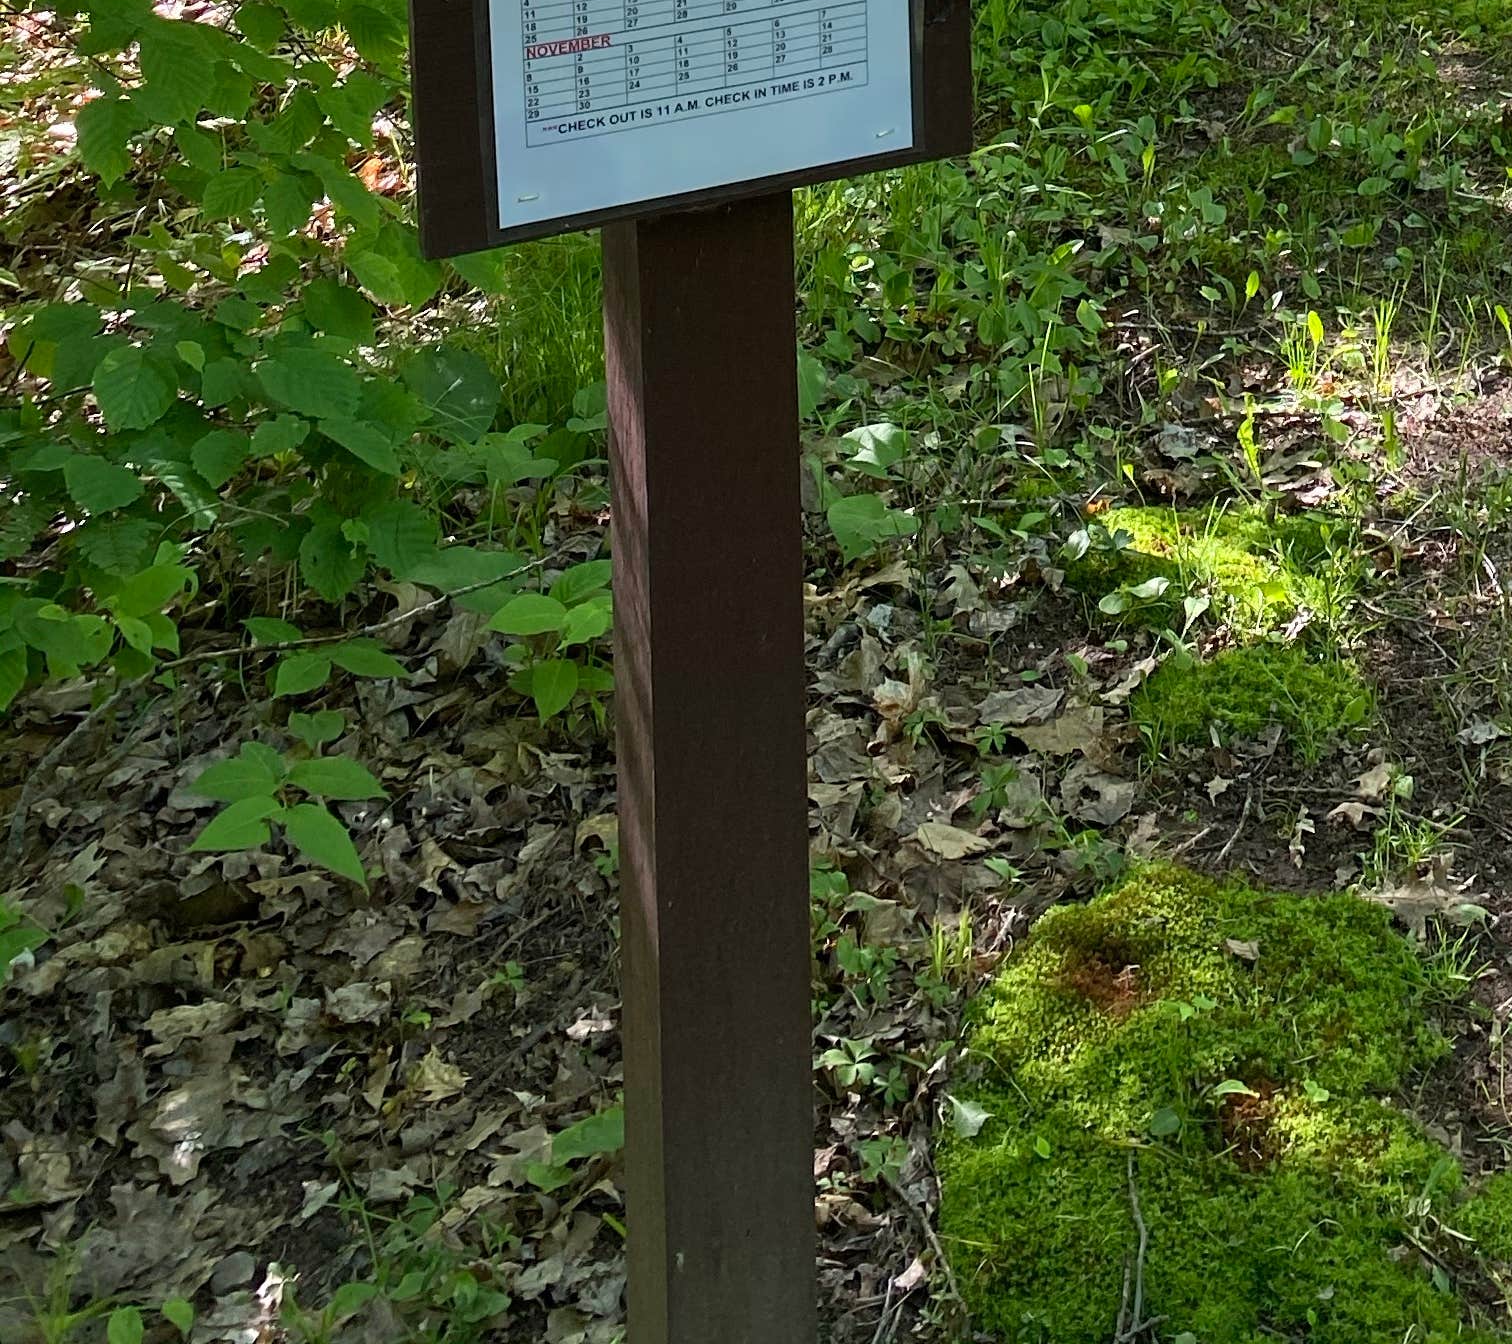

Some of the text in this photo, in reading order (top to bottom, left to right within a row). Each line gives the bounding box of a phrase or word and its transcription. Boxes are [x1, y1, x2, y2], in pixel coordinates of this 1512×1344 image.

[524, 11, 535, 19] 11
[576, 3, 587, 11] 12
[627, 19, 638, 27] 27
[526, 35, 611, 60] NOVEMBER
[528, 34, 832, 94] 15 17 21
[528, 81, 640, 107] 22 23 24
[579, 102, 591, 110] 30
[609, 111, 637, 125] OUT
[640, 108, 653, 120] IS
[657, 105, 670, 116] 11
[704, 91, 750, 108] CHECK
[754, 87, 767, 99] IN
[770, 81, 800, 96] TIME
[803, 78, 815, 89] IS
[817, 76, 825, 87] 2
